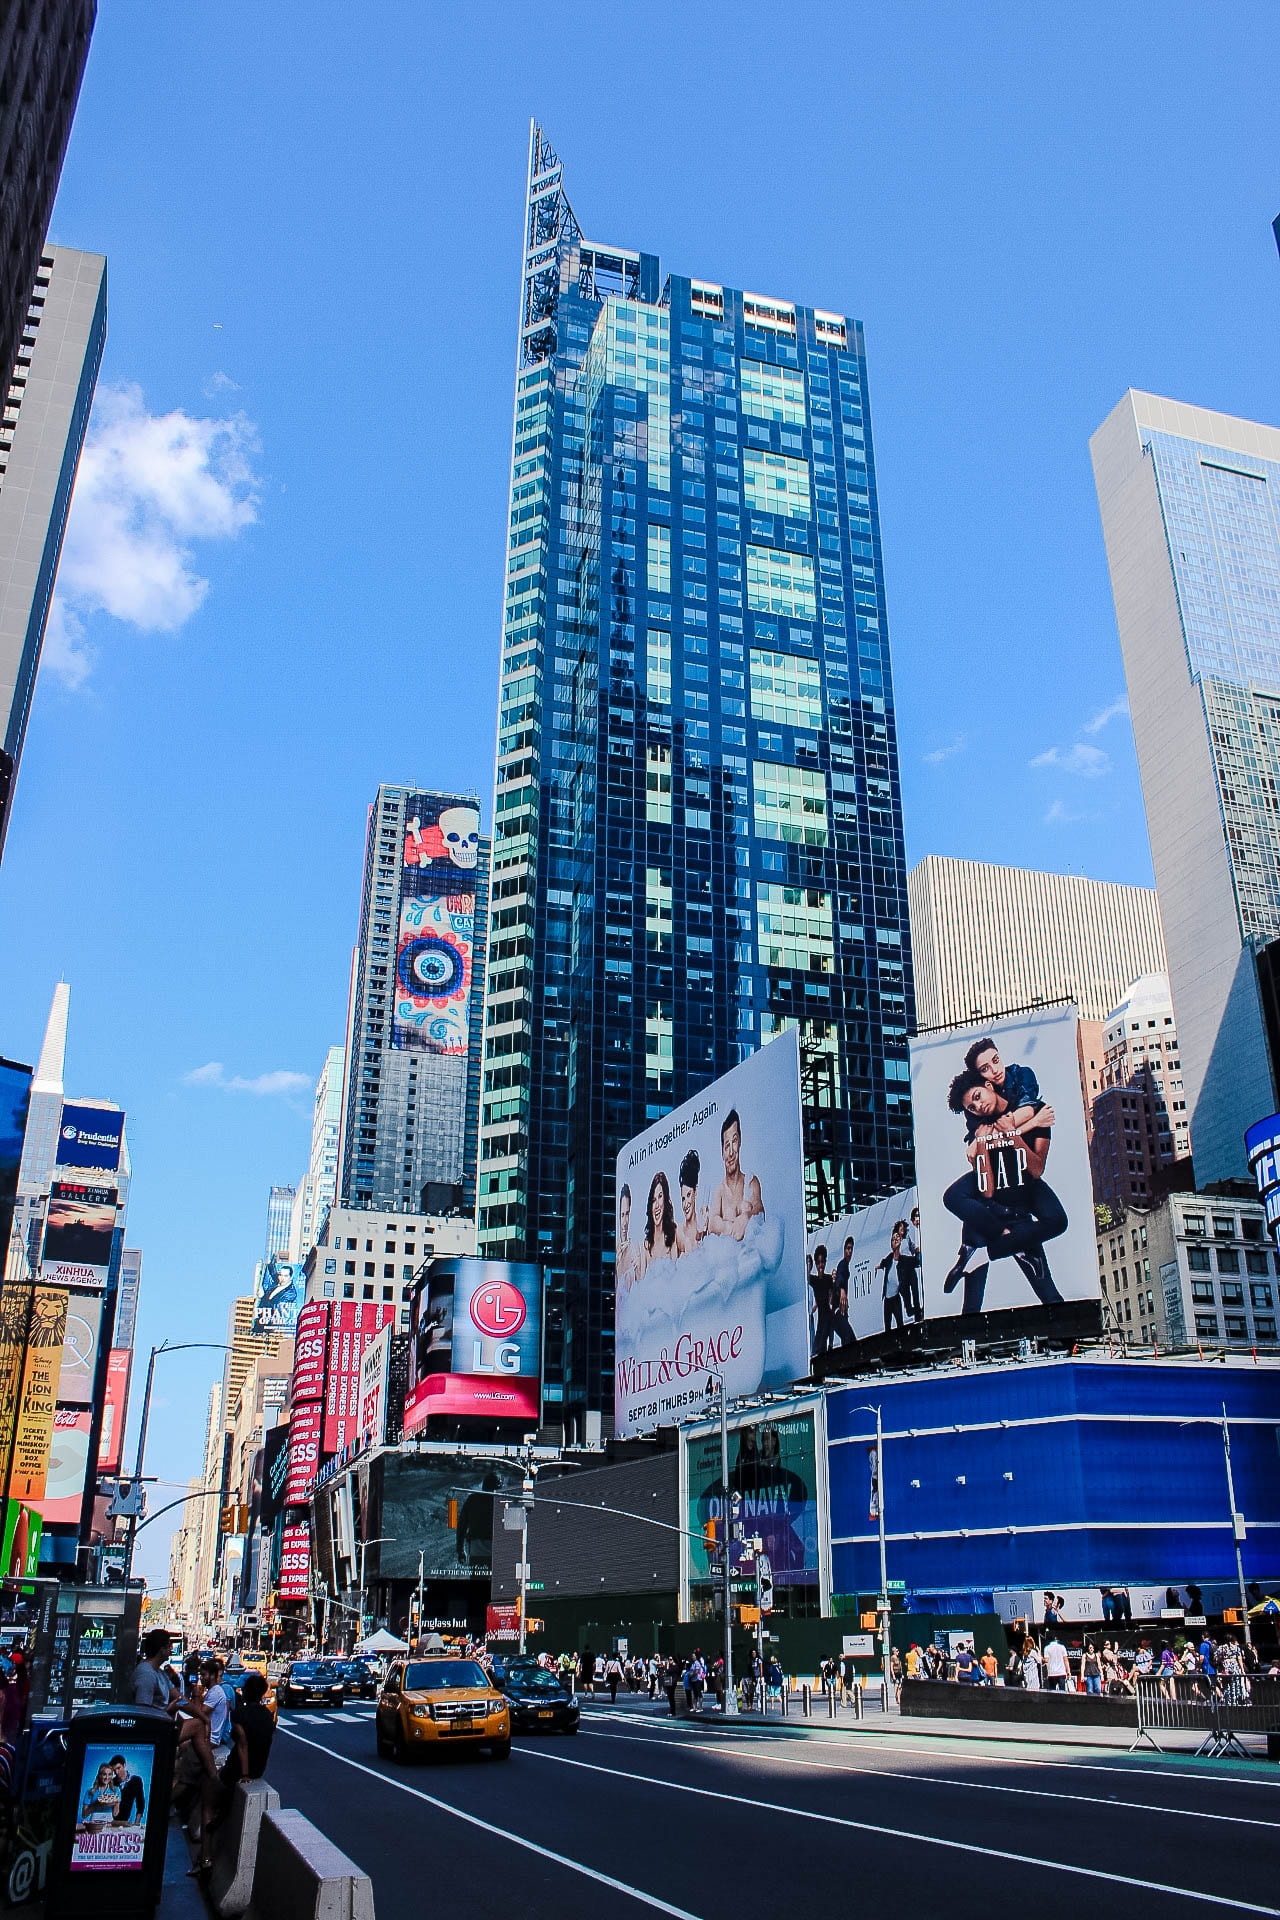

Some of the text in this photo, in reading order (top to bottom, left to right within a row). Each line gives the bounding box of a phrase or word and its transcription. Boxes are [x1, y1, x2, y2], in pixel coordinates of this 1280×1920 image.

[78, 1131, 119, 1143] Prudential
[628, 1101, 719, 1169] All in it together. Again.
[977, 1129, 1022, 1143] meet me
[985, 1139, 1015, 1150] in the
[976, 1147, 1028, 1193] GAP
[61, 1191, 108, 1202] GALLERY
[46, 1273, 103, 1285] NEWS AGENCY
[55, 1265, 95, 1278] XINHUA
[853, 1270, 872, 1299] GAP
[331, 1331, 340, 1371] EXPRESS
[341, 1332, 351, 1372] EXPRESS
[352, 1332, 361, 1372] EXPRESS
[472, 1341, 521, 1374] LG
[32, 1371, 49, 1380] THE
[27, 1381, 52, 1395] LION
[328, 1375, 337, 1416] EXPRESS
[338, 1376, 348, 1417] EXPRESS
[349, 1376, 359, 1417] EXPRESS
[474, 1392, 516, 1401] www.LG.com
[23, 1395, 53, 1415] KING
[628, 1389, 704, 1422] SEPT 28 THURS 9PM
[23, 1427, 47, 1435] TICKETS
[19, 1447, 46, 1455] THEATRE
[744, 1483, 793, 1518] NAVY
[737, 1583, 743, 1591] W
[452, 1617, 467, 1628] hut
[84, 1629, 104, 1638] ATM
[78, 1833, 142, 1854] WAITRESS
